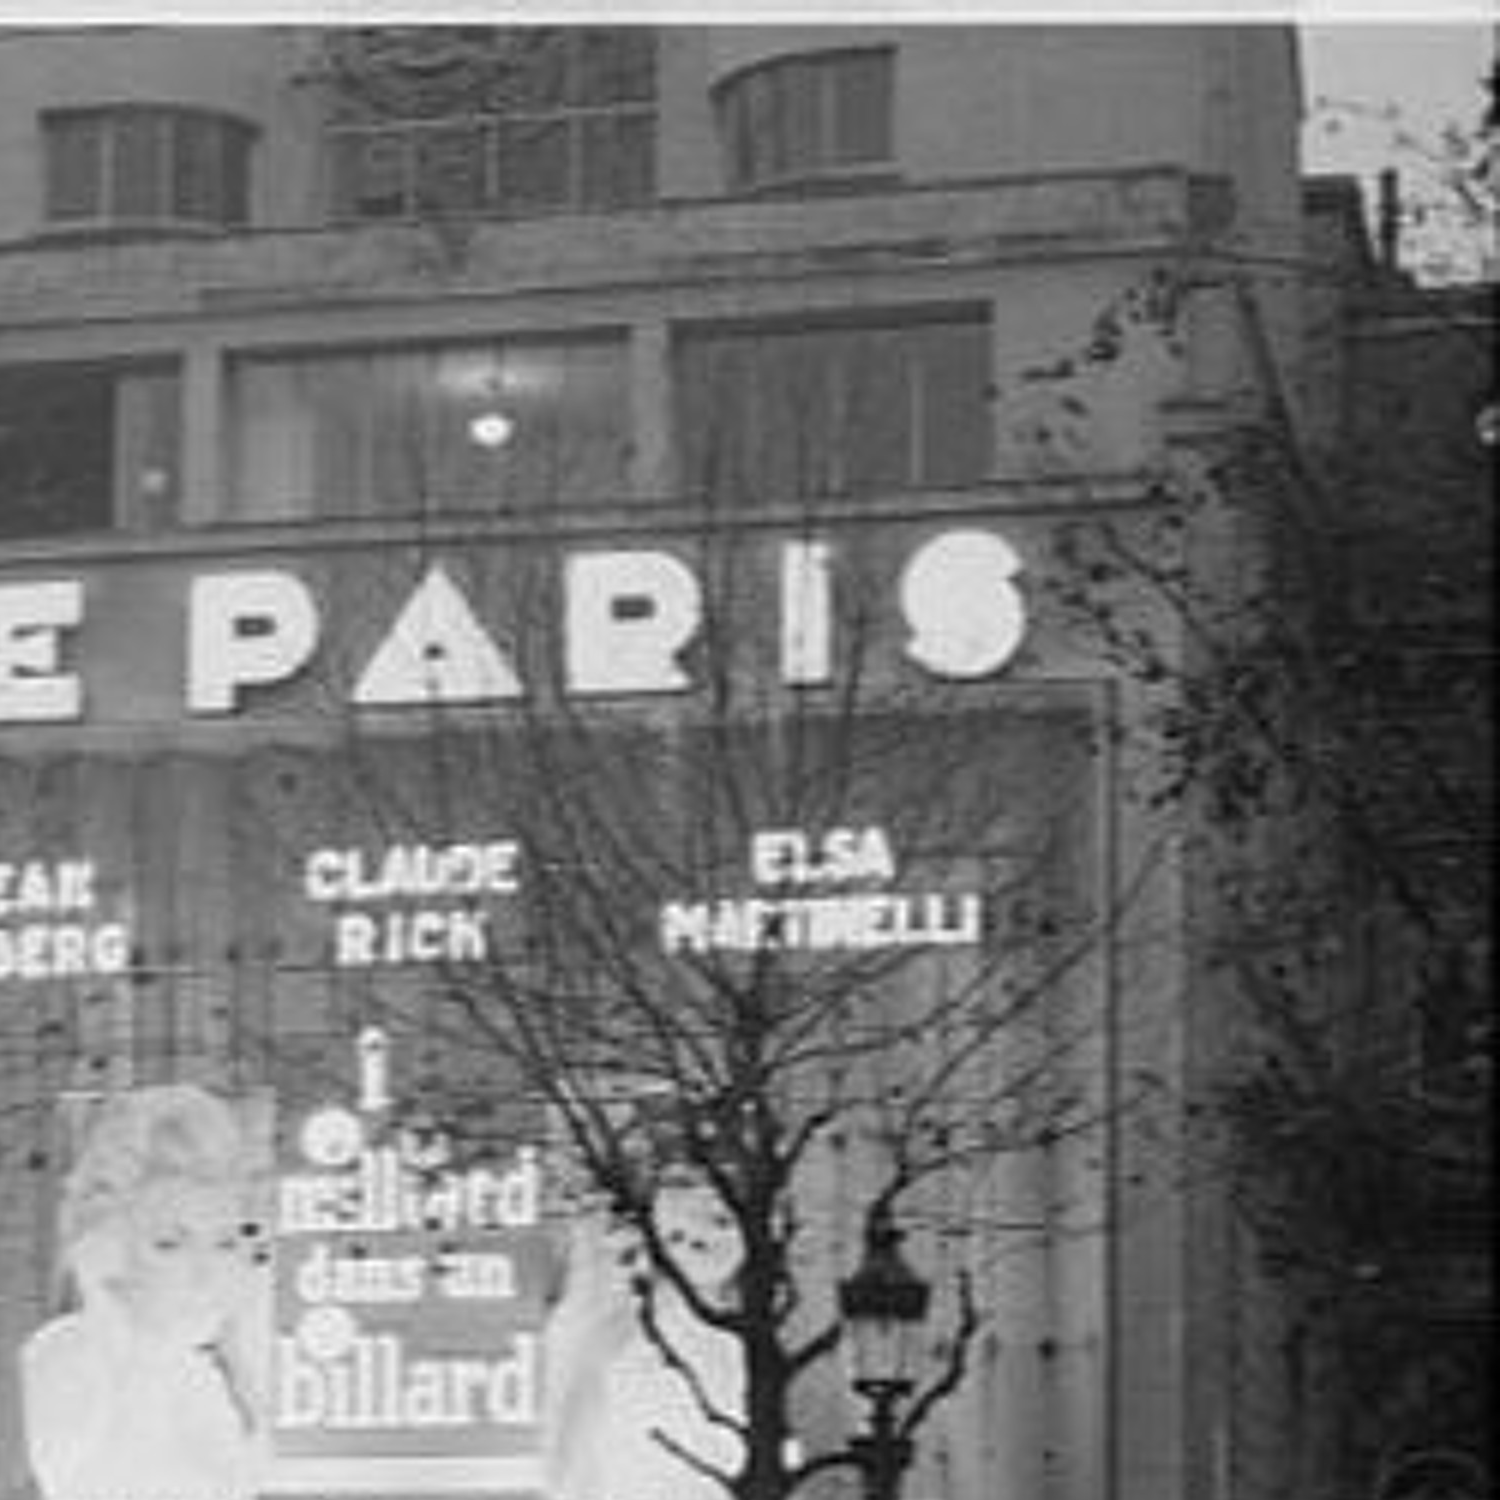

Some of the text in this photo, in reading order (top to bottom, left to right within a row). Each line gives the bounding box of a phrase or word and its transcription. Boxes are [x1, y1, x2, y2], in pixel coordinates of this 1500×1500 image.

[186, 529, 1030, 714] PARIS
[305, 843, 518, 900] CLAUDE
[752, 826, 896, 884] ELSA
[335, 909, 486, 966] RICK
[274, 1307, 536, 1429] billard
